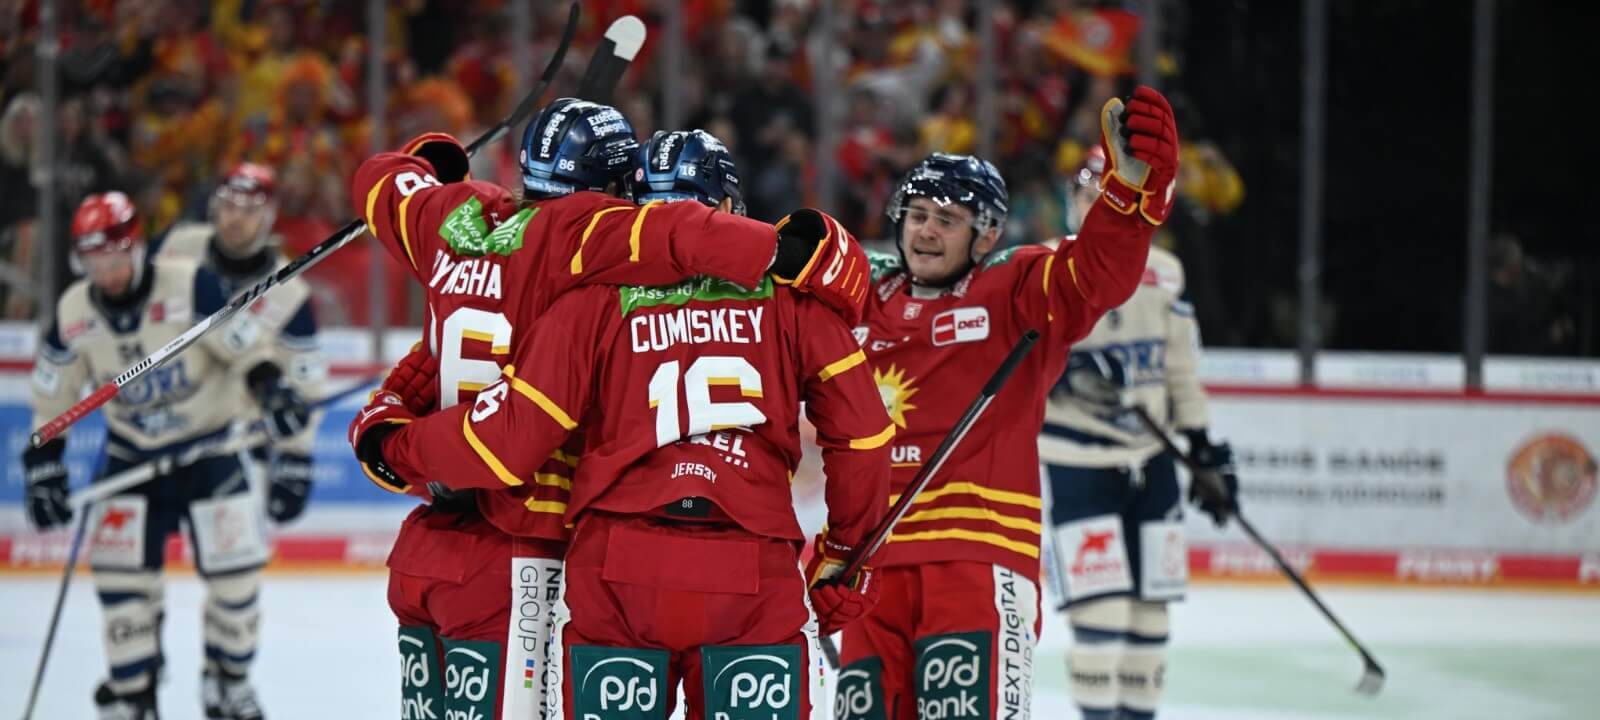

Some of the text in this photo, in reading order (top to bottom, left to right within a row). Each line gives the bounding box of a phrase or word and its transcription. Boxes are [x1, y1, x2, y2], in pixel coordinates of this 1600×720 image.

[559, 159, 575, 171] 86
[608, 156, 628, 166] CCM
[681, 165, 696, 177] 16
[630, 306, 764, 353] CUMISKEY
[648, 356, 767, 448] 16
[681, 499, 694, 509] 88
[519, 565, 540, 652] GROUP
[1000, 569, 1020, 720] NEXT DIGITAL
[730, 672, 791, 709] psd
[923, 655, 979, 691] psd
[600, 676, 657, 711] psd
